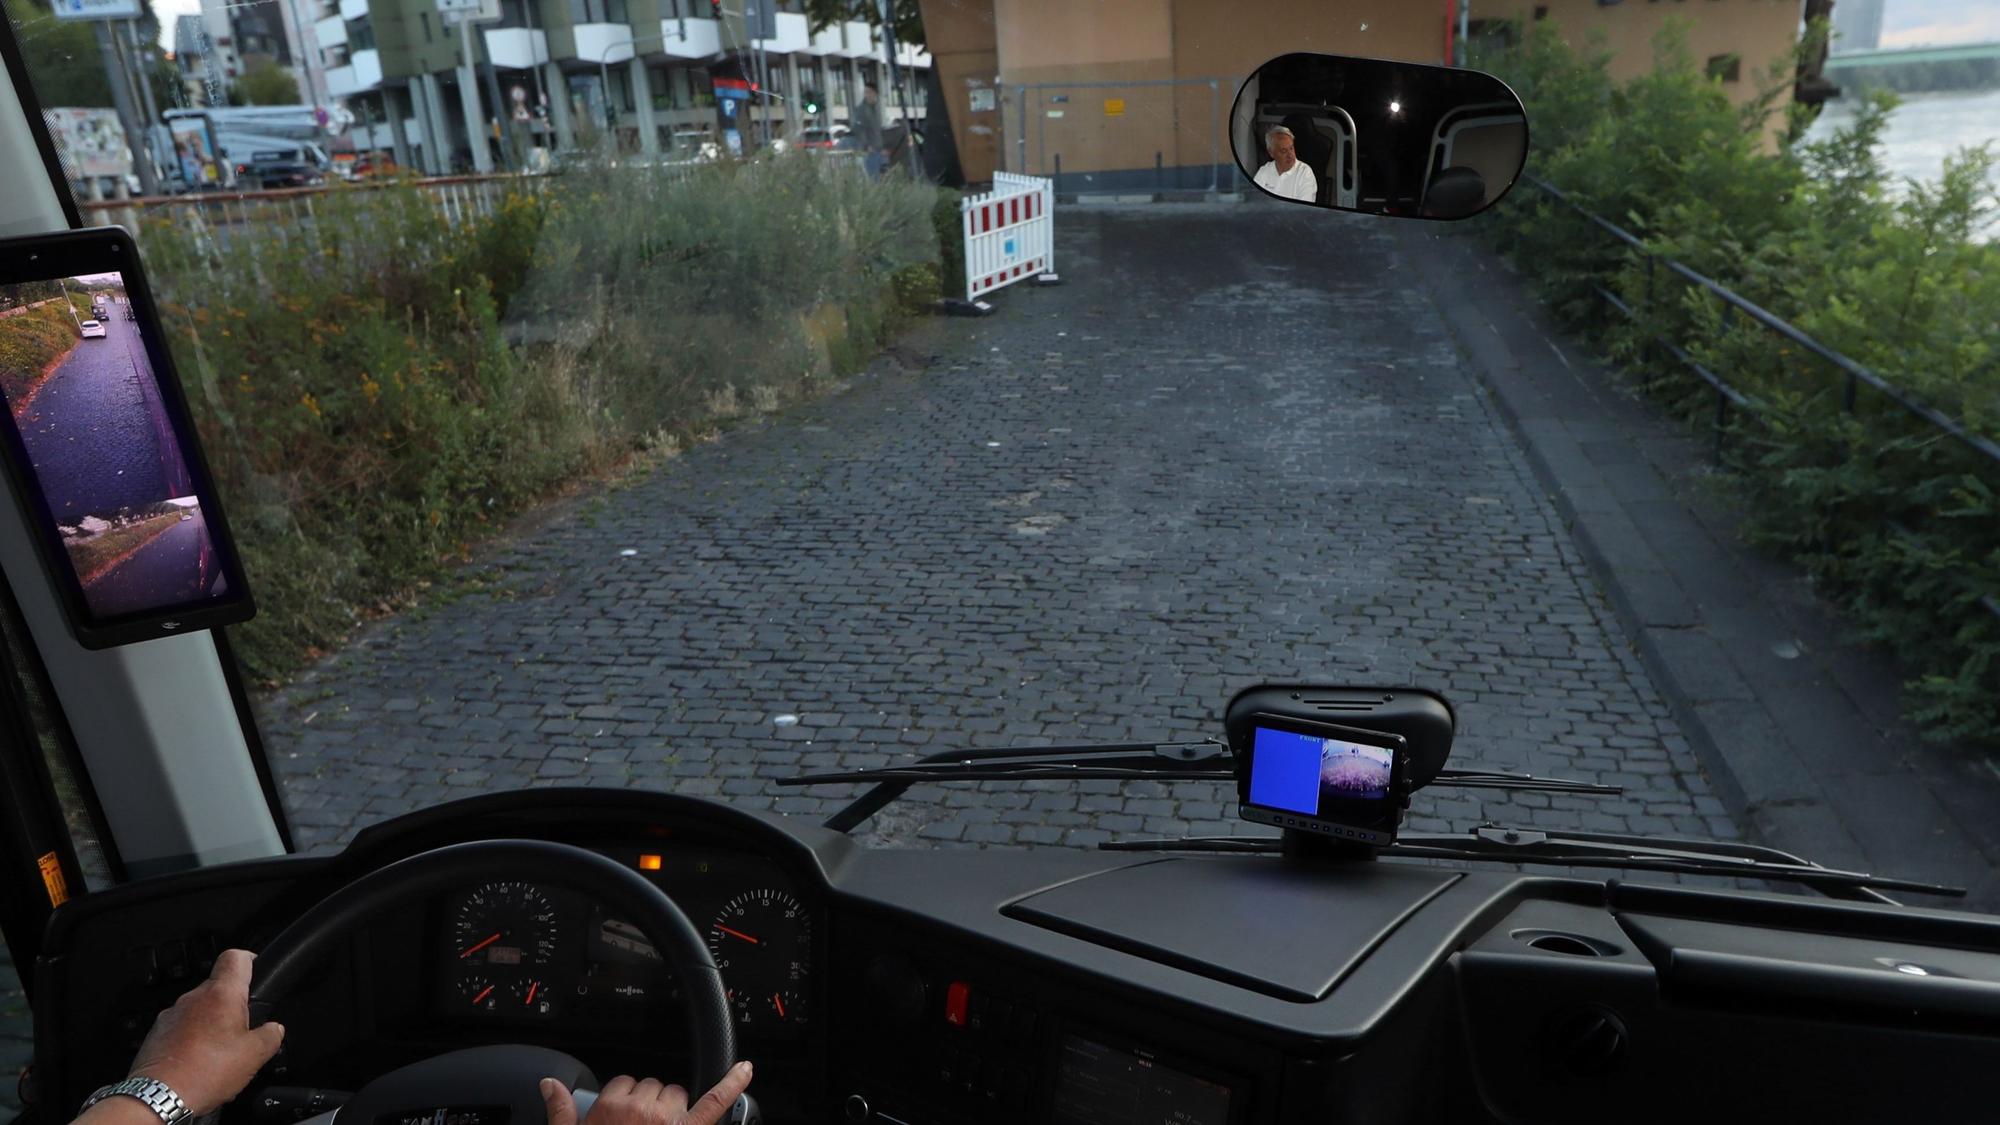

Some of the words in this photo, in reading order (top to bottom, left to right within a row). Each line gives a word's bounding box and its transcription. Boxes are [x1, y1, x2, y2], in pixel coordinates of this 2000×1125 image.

[723, 99, 735, 116] P
[736, 908, 745, 916] 10
[785, 910, 796, 918] 20
[723, 959, 729, 968] 0
